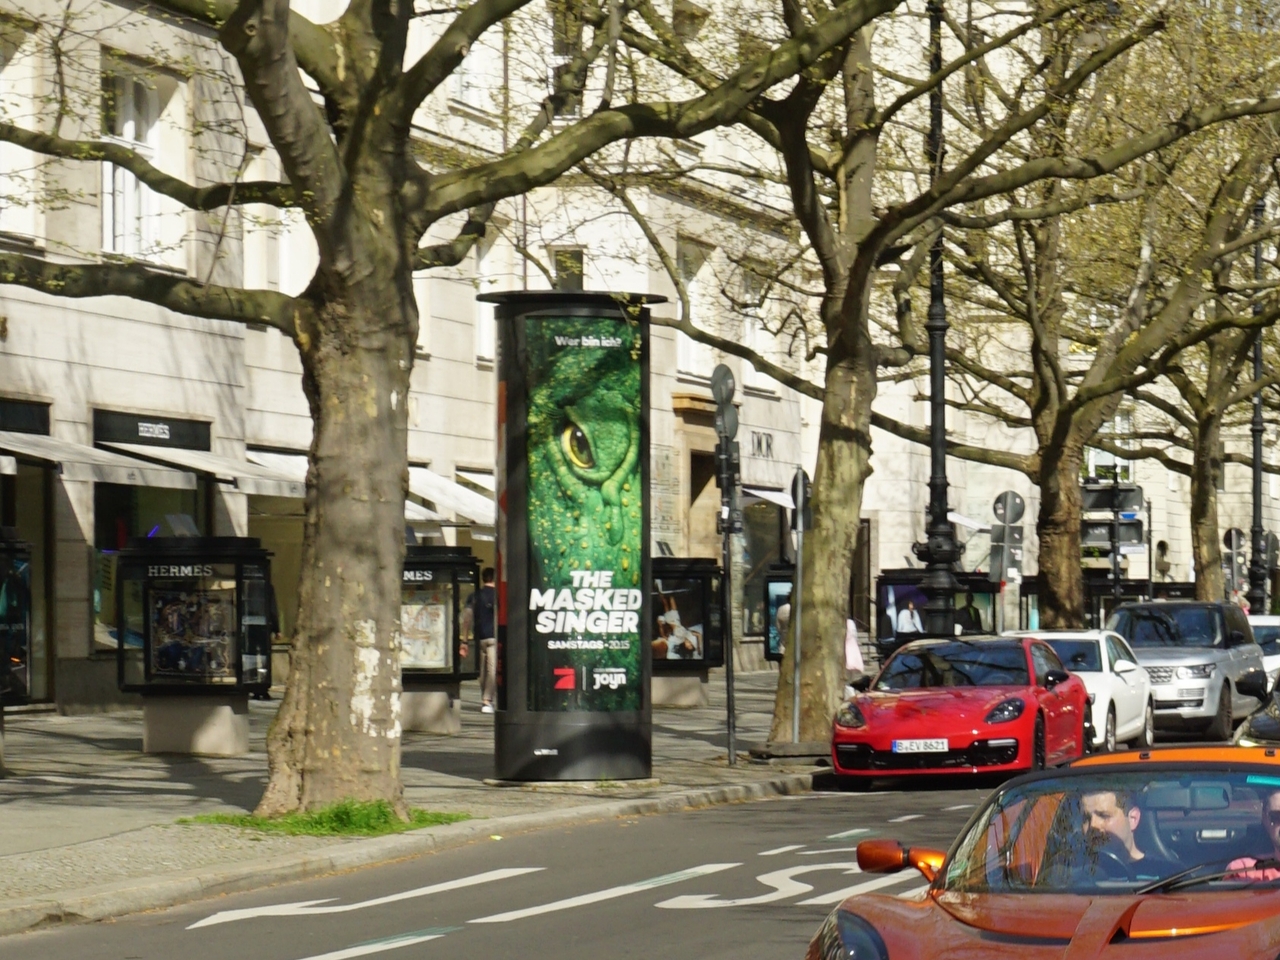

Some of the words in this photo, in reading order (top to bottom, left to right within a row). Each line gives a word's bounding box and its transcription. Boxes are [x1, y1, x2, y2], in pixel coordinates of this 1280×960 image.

[569, 570, 614, 588] THE
[529, 588, 642, 611] MASKED
[535, 610, 639, 633] SINGER
[547, 640, 604, 650] SAMSTAGS
[593, 673, 627, 690] joyn
